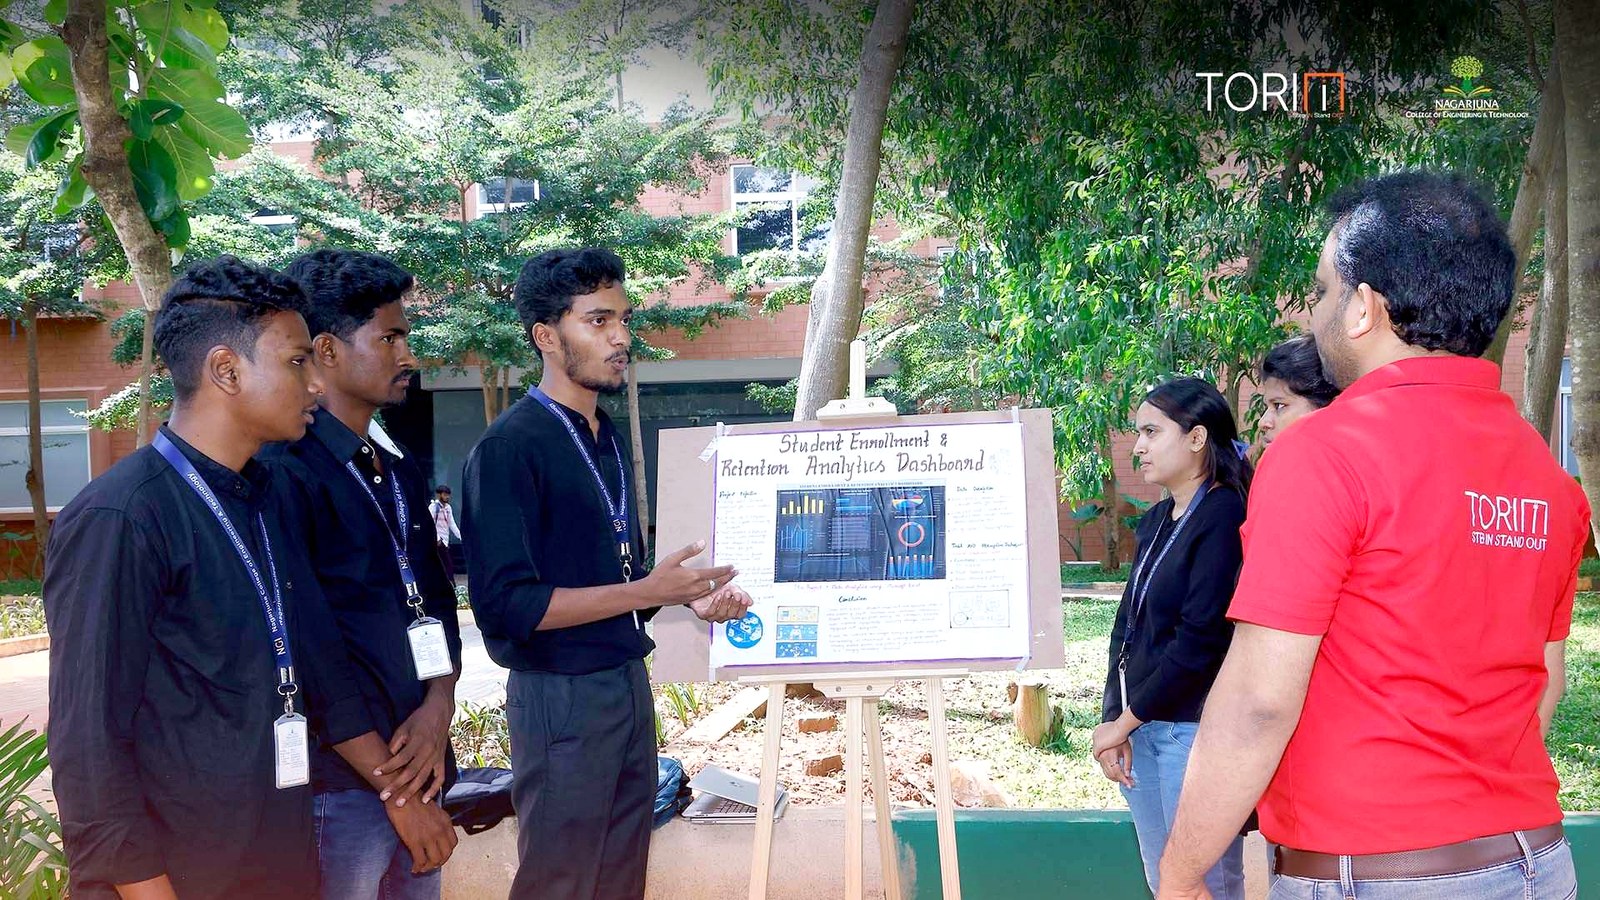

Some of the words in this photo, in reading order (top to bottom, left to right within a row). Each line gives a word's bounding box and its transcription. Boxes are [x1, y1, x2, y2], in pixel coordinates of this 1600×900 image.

[548, 402, 571, 428] Technology
[573, 433, 591, 463] Engineering
[779, 433, 844, 453] Student
[850, 430, 930, 450] Enrollment
[939, 433, 948, 446] &
[721, 459, 789, 477] Retention
[805, 455, 886, 481] Analytics
[897, 449, 985, 472] Dashboard
[187, 472, 219, 510] Technology
[594, 470, 605, 489] College
[398, 501, 406, 522] College
[603, 489, 615, 516] Nagarjuna
[222, 518, 249, 558] Engineering
[613, 519, 623, 532] NGI
[1495, 534, 1524, 548] STAND
[1526, 537, 1547, 551] OUT
[252, 568, 266, 595] College
[262, 596, 278, 632] Nagarjuna
[274, 637, 287, 656] NGI
